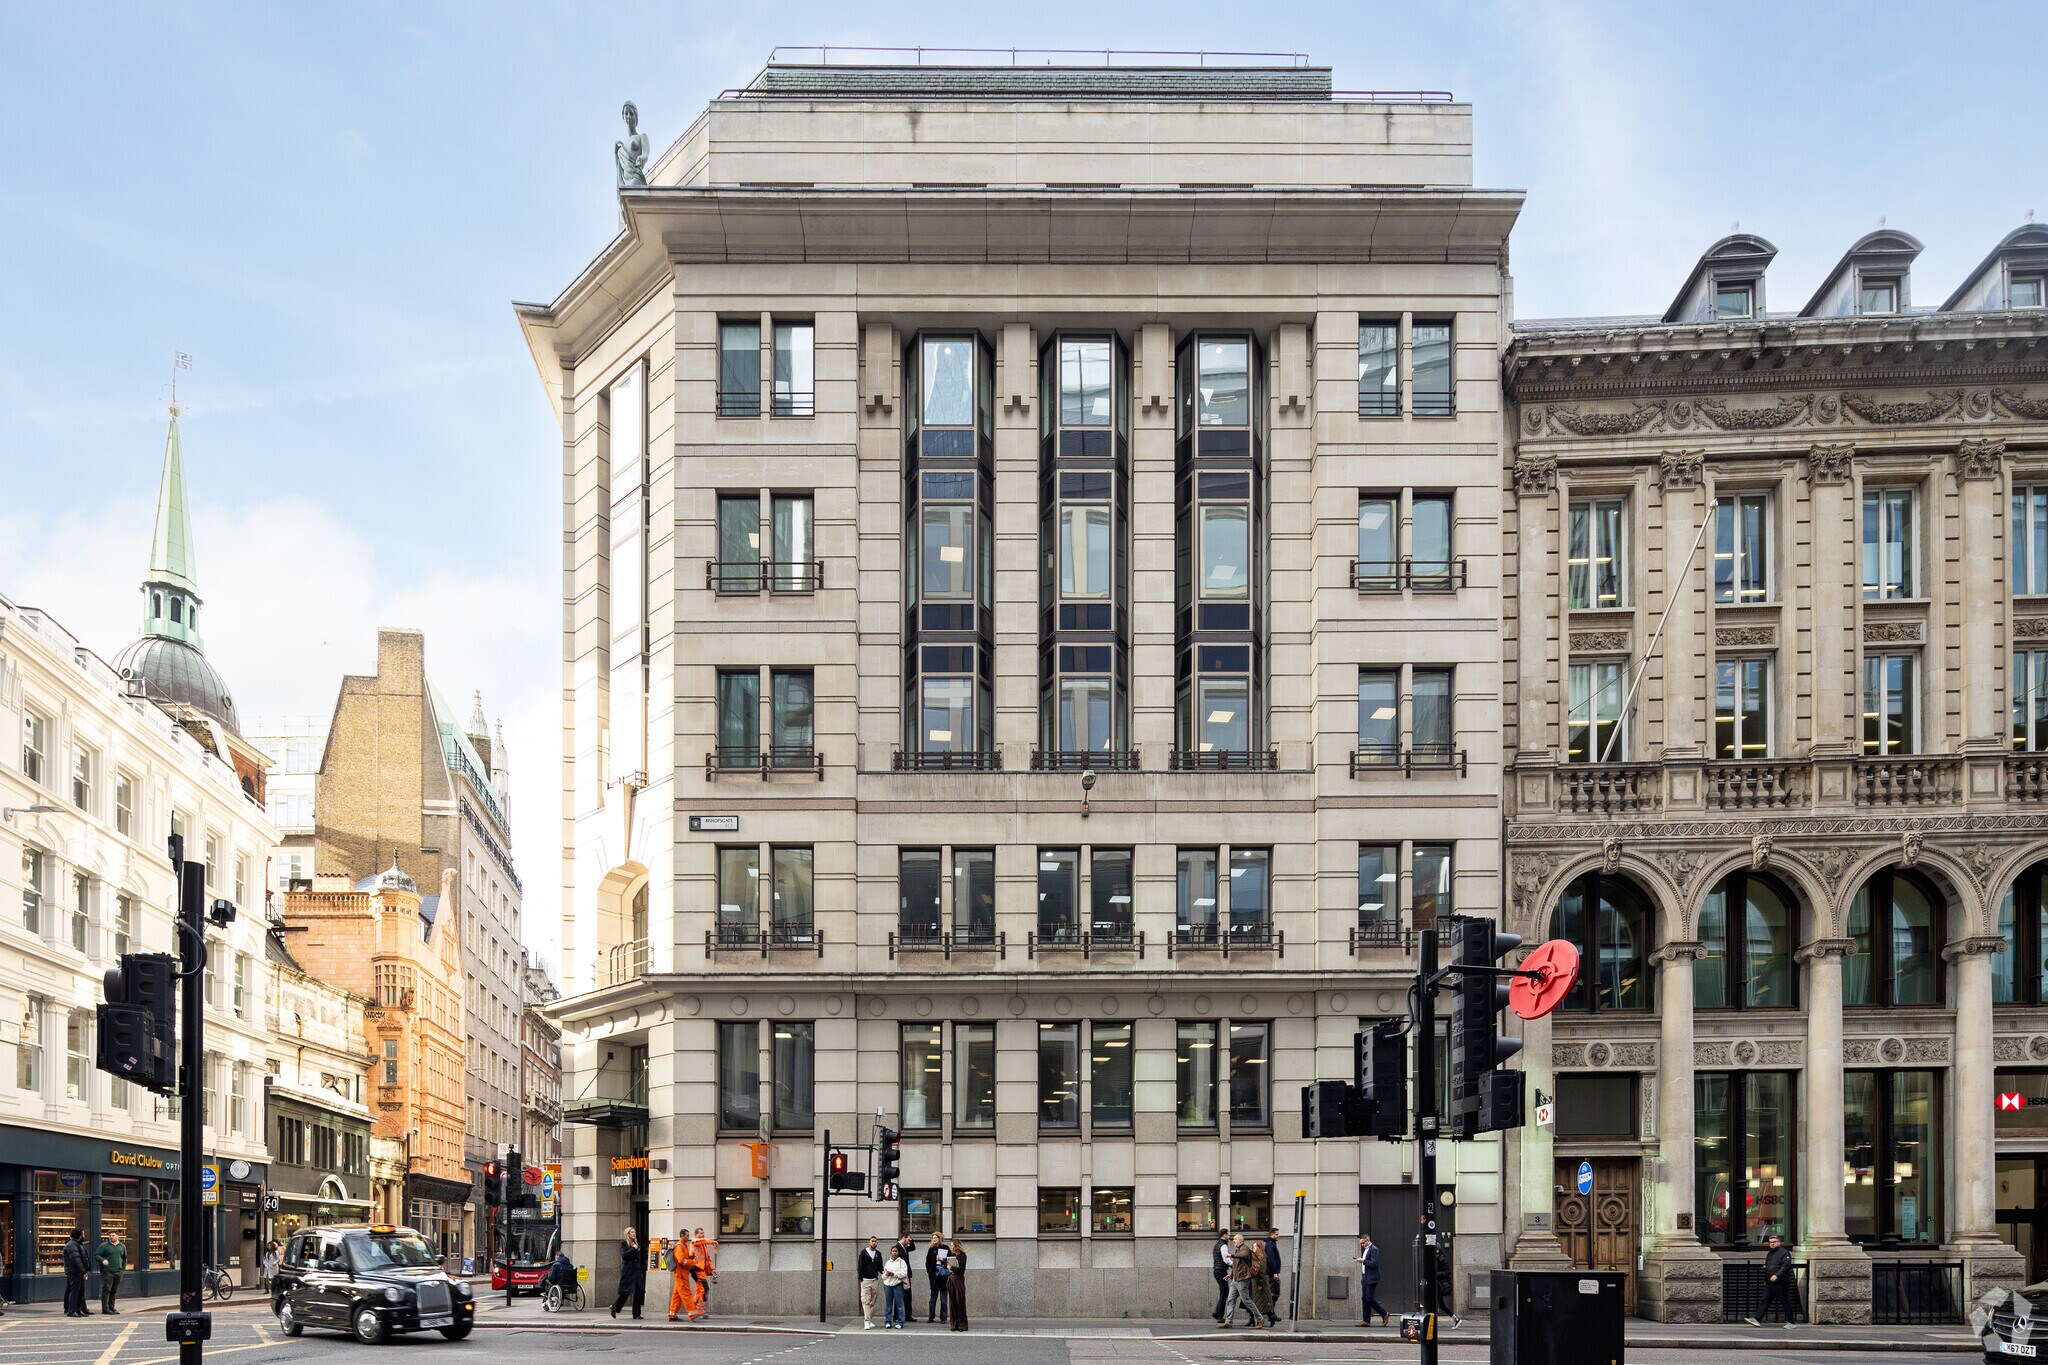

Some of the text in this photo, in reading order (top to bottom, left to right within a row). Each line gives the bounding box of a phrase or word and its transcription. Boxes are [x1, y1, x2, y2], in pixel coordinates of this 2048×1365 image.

[2027, 1097, 2048, 1106] HSB
[112, 1150, 136, 1166] David
[137, 1154, 163, 1169] Clulow
[611, 1155, 649, 1171] Sainsbury
[611, 1171, 633, 1187] Local
[265, 1198, 278, 1209] 60
[1755, 1195, 1785, 1205] HSBC
[1535, 1215, 1540, 1223] 3
[1682, 1215, 1690, 1226] 3
